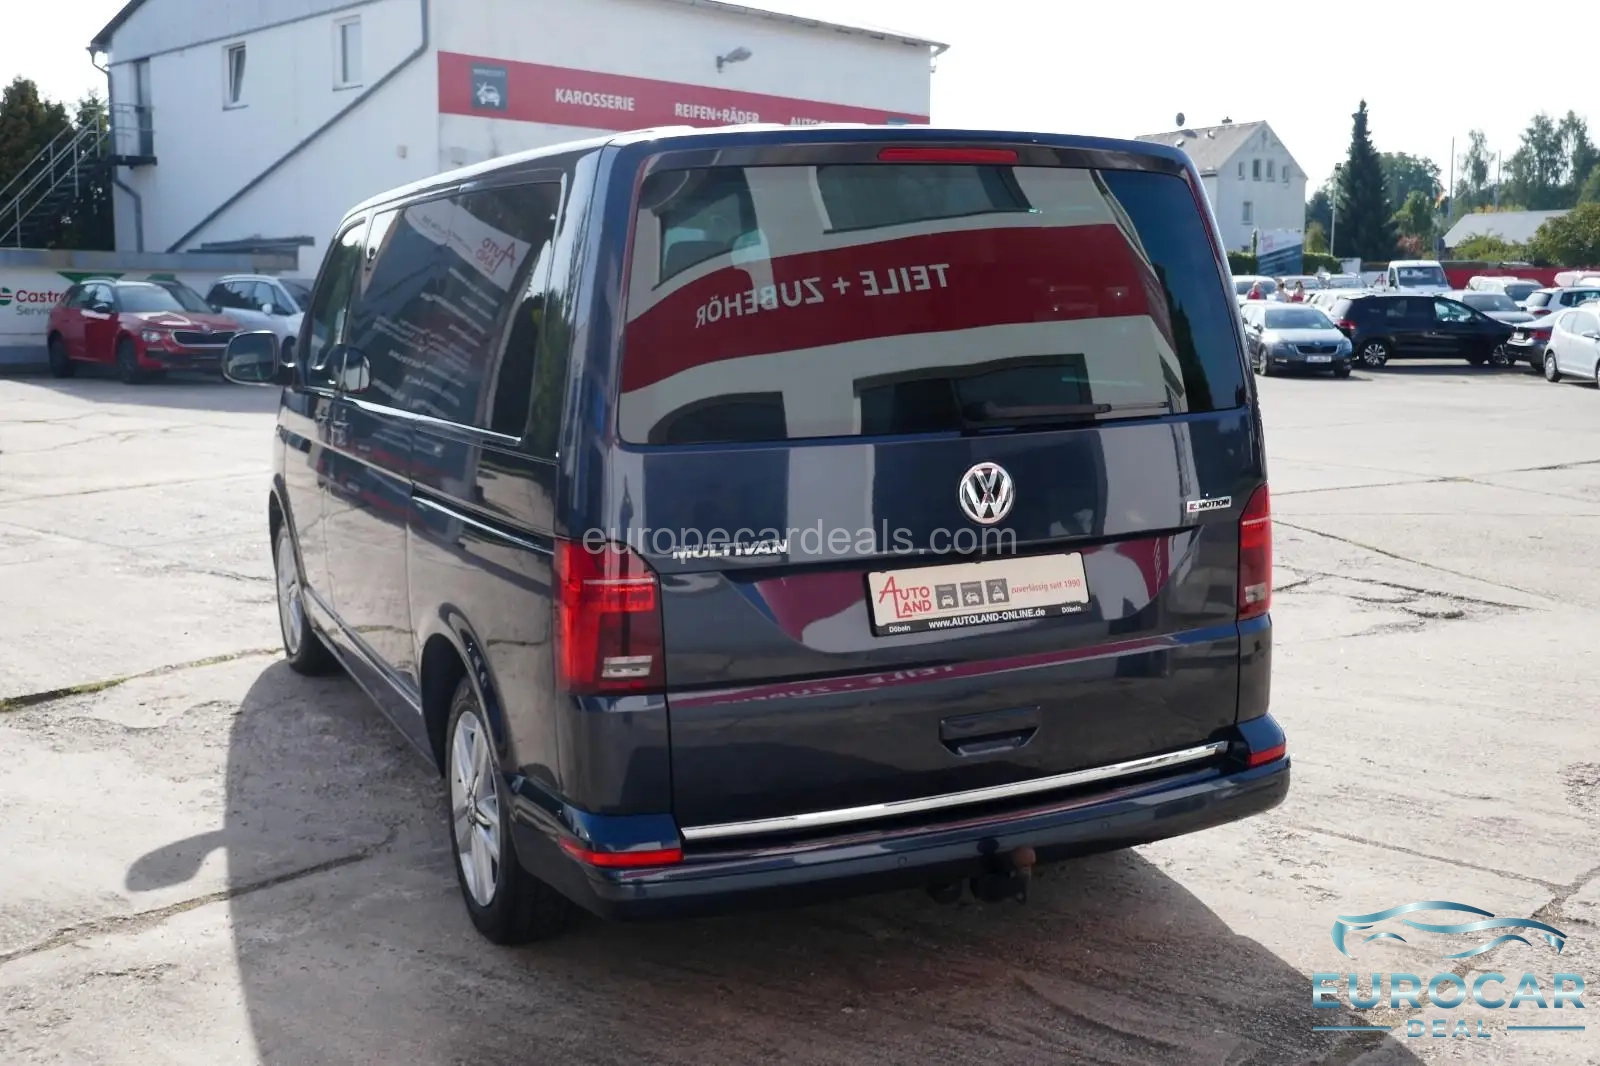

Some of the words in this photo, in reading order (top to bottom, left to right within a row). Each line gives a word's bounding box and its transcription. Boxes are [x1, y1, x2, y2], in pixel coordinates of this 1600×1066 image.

[555, 88, 635, 111] KAROSSERIE
[675, 103, 760, 124] REIFEN+RÄDER
[960, 462, 1014, 525] VW
[672, 539, 788, 560] MULTIVAN
[879, 576, 930, 604] AUTO
[1064, 578, 1081, 588] 1990
[895, 599, 932, 619] LAND
[928, 607, 1046, 629] www.AUTOLAND-ONLINE.de
